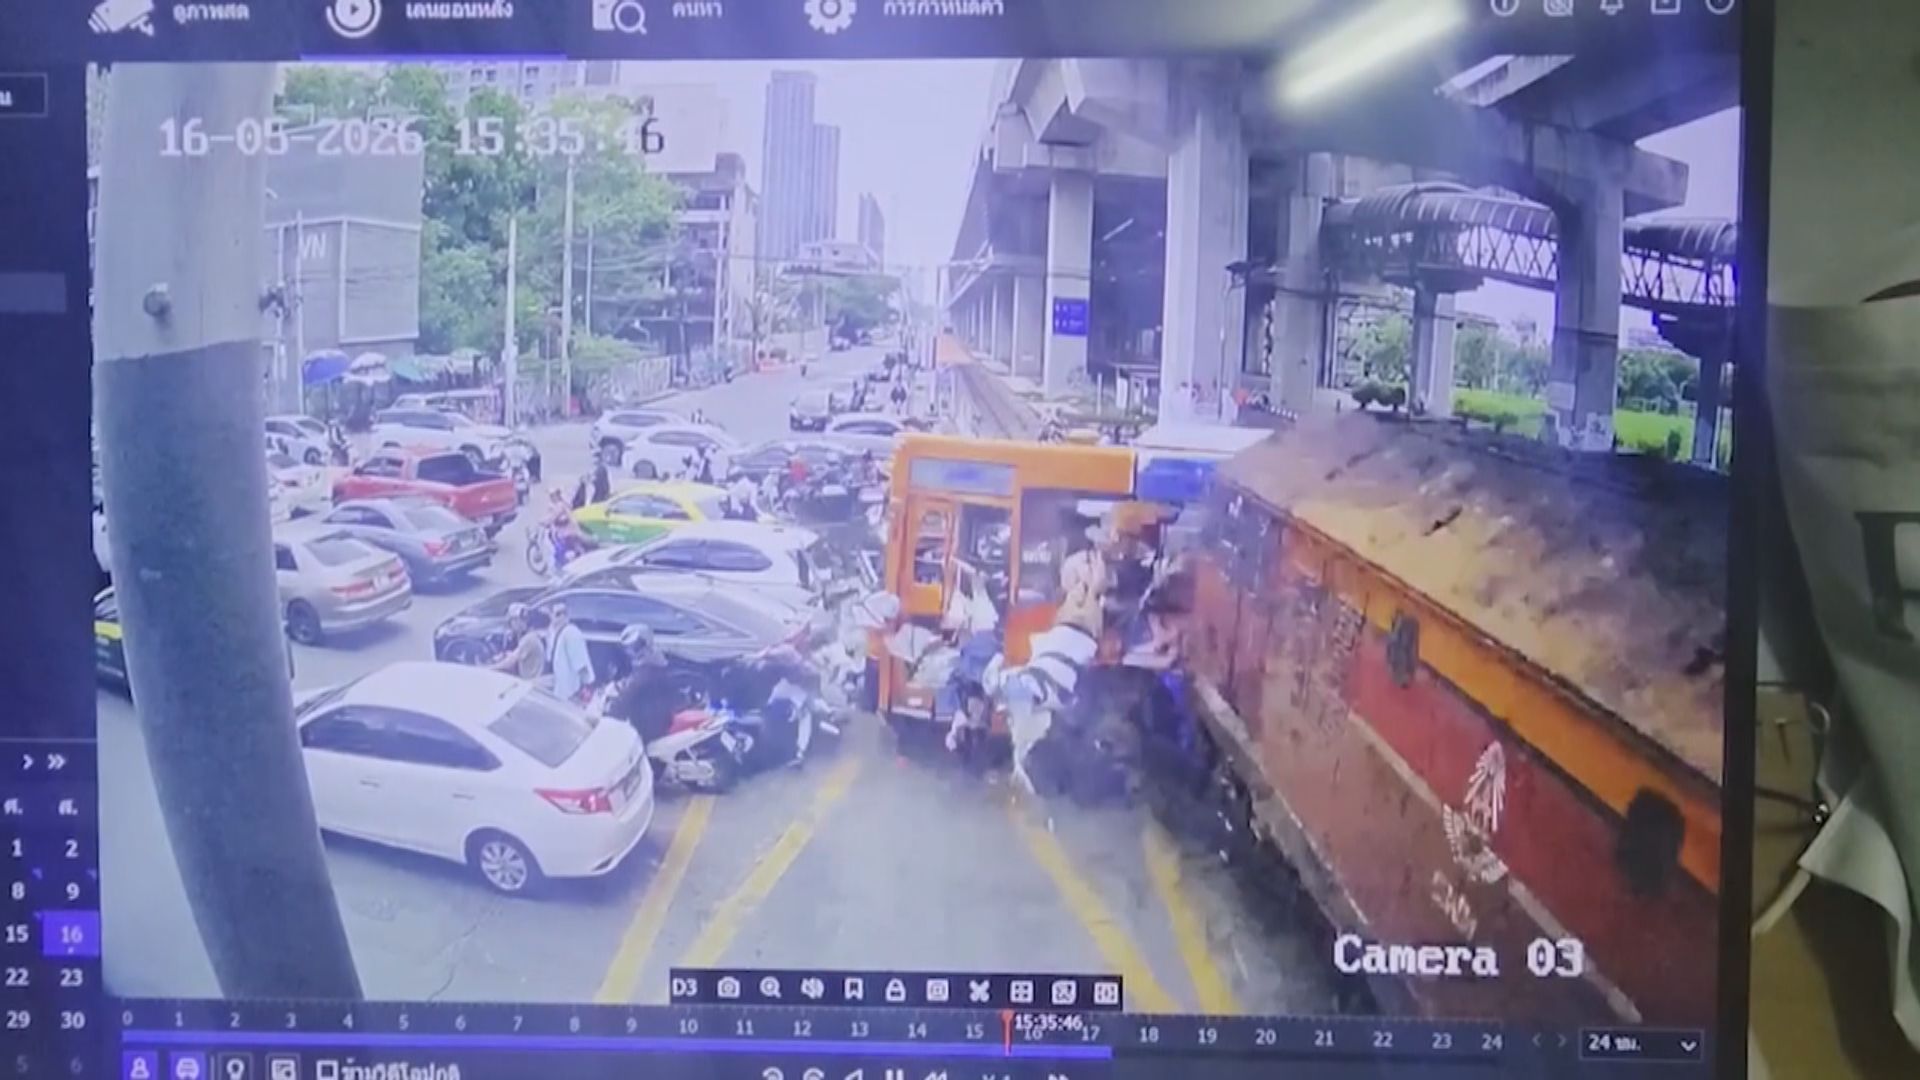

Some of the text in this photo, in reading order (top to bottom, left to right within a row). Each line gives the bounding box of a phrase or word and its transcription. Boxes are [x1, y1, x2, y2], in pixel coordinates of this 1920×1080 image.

[159, 117, 665, 156] 16-05-2026 15:35:46
[12, 838, 79, 859] 1 2
[11, 881, 80, 901] 8 9
[6, 924, 83, 944] 15 16
[1333, 933, 1586, 978] Camera 03
[5, 967, 83, 987] 22 23
[7, 1010, 86, 1030] 29 30
[122, 1010, 134, 1026] 0
[175, 1012, 184, 1027] 1
[231, 1012, 241, 1028] 2
[286, 1013, 296, 1029] 3
[342, 1014, 354, 1029] 4
[399, 1014, 409, 1030] 5
[455, 1016, 466, 1031] 6
[513, 1016, 523, 1031] 7
[569, 1017, 580, 1032] 8
[626, 1018, 638, 1033] 9
[679, 1018, 699, 1034] 10
[736, 1020, 754, 1036] 11
[793, 1021, 812, 1037] 12
[850, 1022, 870, 1038] 13
[908, 1023, 928, 1039] 14
[966, 1024, 984, 1039] 15
[1081, 1026, 1101, 1041] 17
[1140, 1027, 1159, 1043] 18
[1198, 1028, 1217, 1044] 19
[1256, 1029, 1276, 1045] 20
[1315, 1030, 1334, 1046] 21
[1373, 1031, 1392, 1047] 22
[1432, 1033, 1452, 1049] 23
[1482, 1034, 1502, 1050] 24
[1014, 1014, 1083, 1031] 15:35:46
[1589, 1034, 1610, 1051] 24
